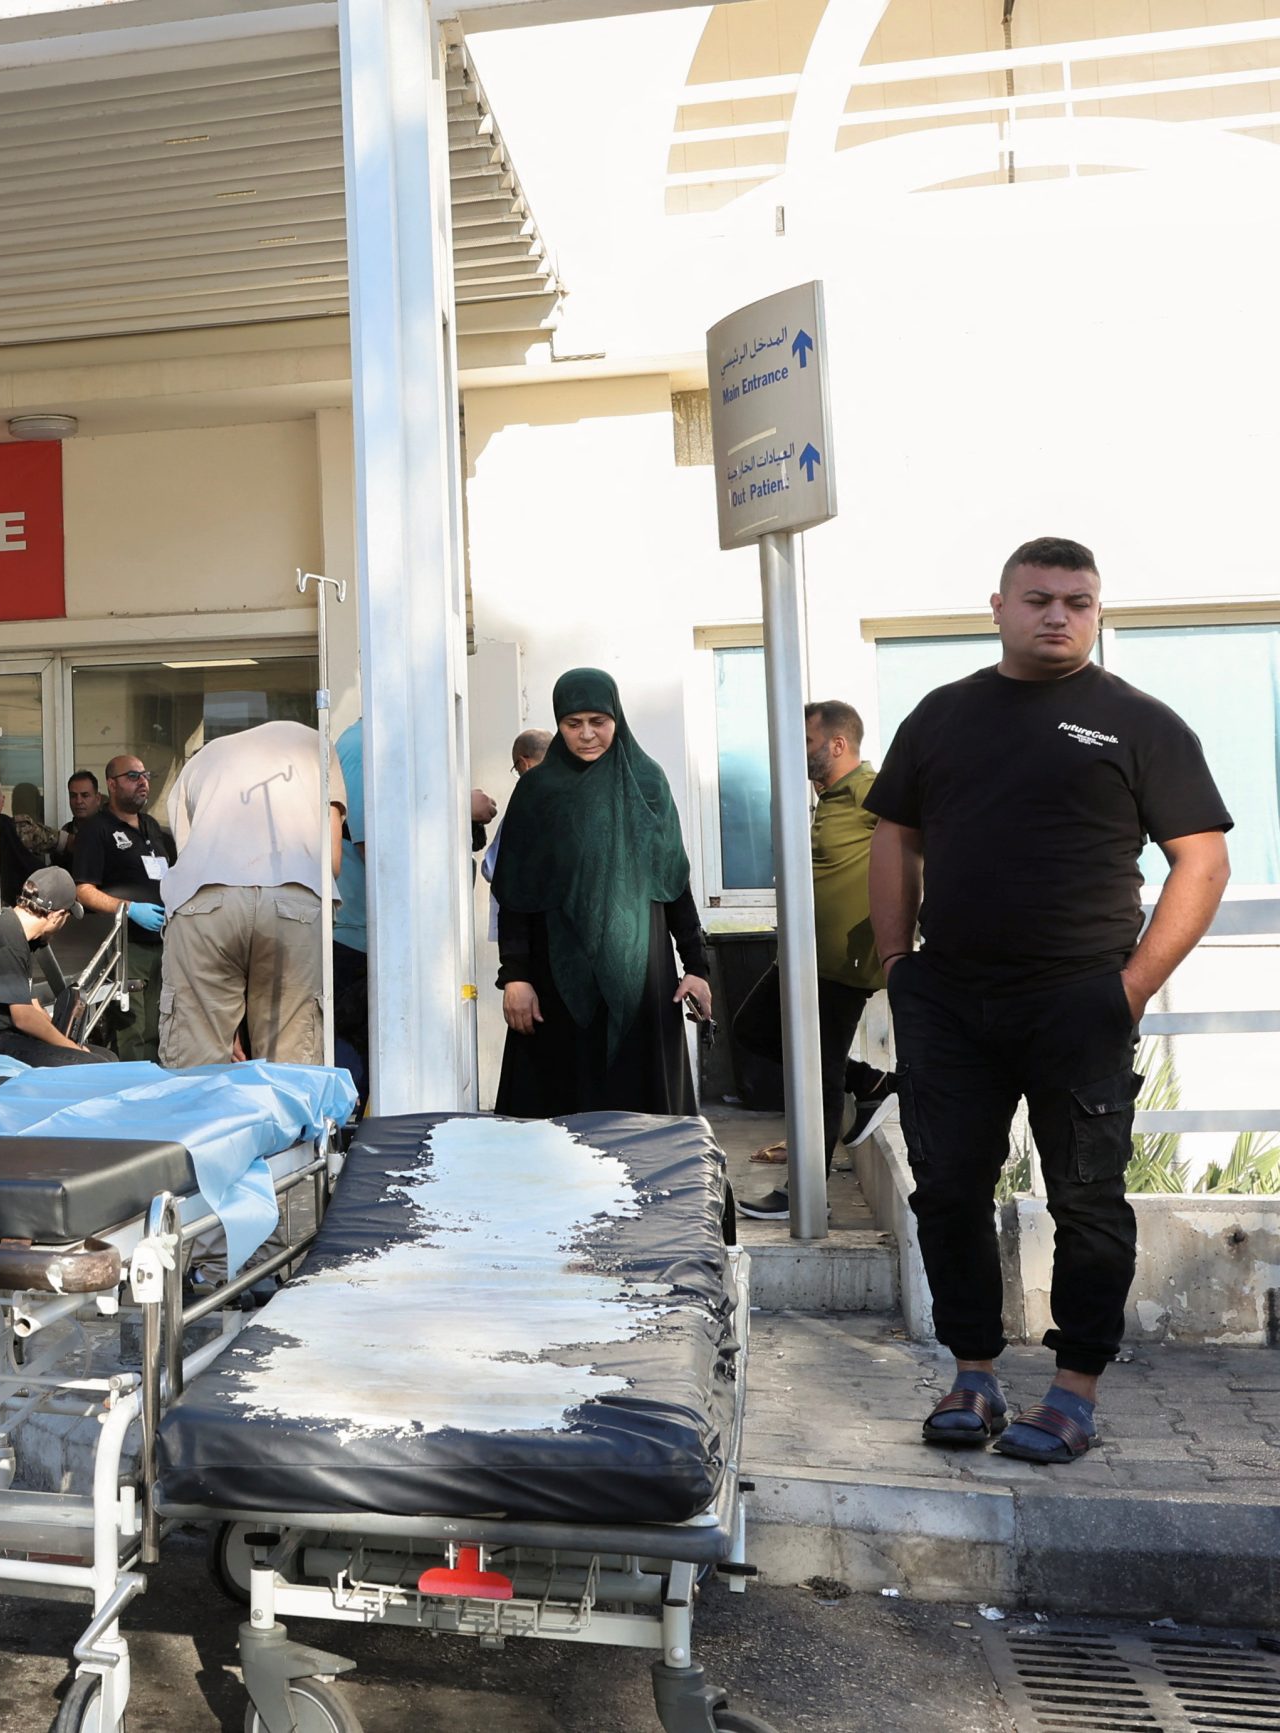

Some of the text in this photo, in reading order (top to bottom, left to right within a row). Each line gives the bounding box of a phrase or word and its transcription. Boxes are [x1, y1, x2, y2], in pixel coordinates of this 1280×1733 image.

[721, 326, 787, 380] المدخل الرئيسي
[722, 367, 789, 405] Main Entrance
[757, 442, 795, 468] العيادات
[732, 487, 746, 507] Out
